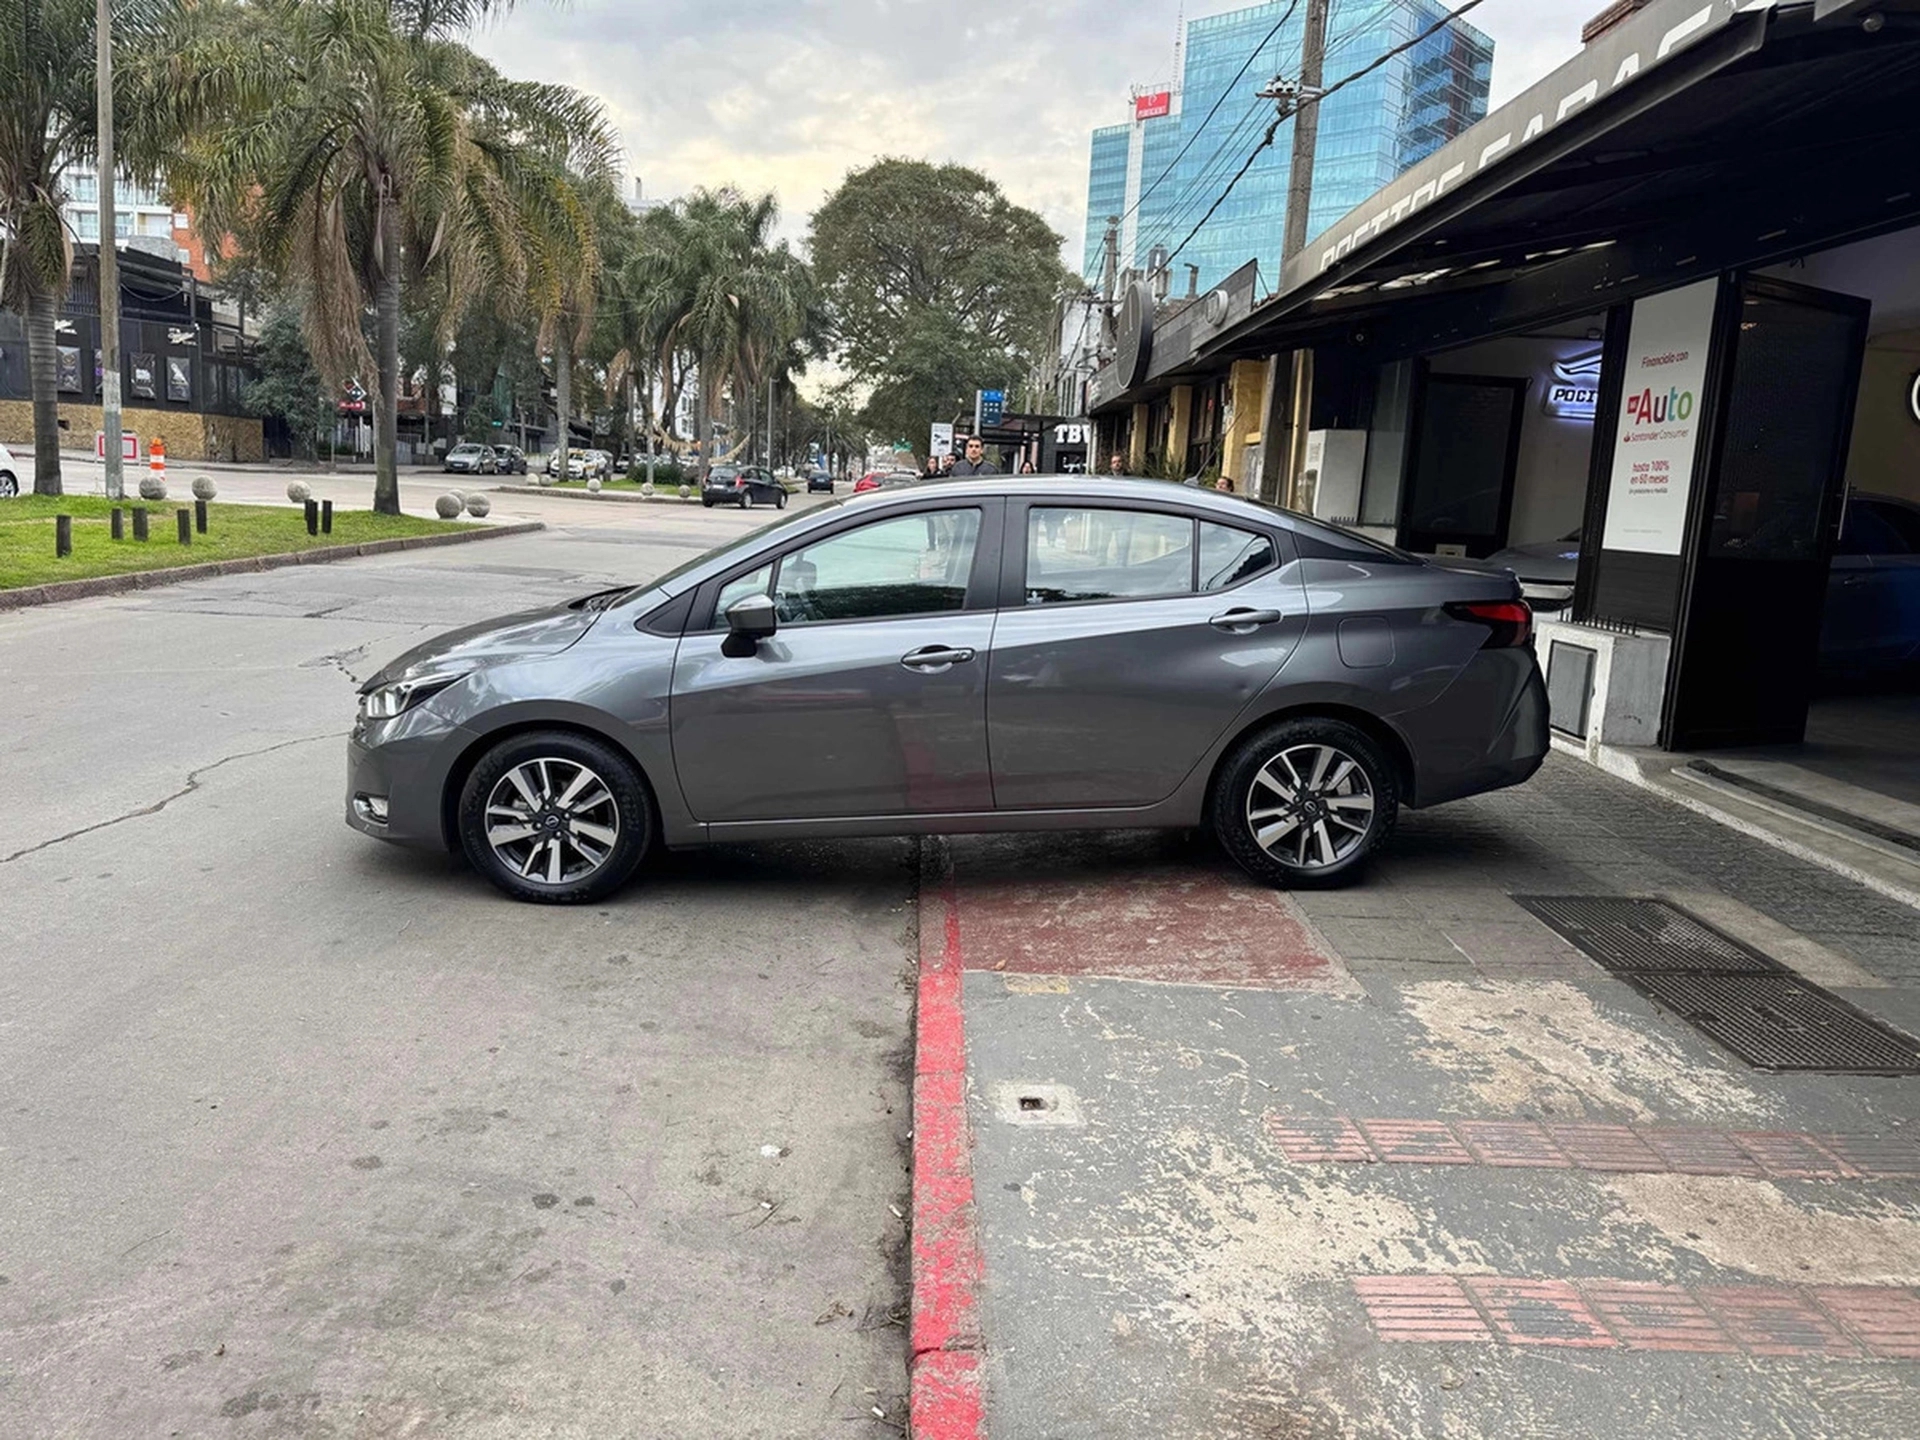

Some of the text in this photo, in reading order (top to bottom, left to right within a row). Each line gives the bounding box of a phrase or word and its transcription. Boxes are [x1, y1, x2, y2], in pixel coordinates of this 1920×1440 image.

[1553, 388, 1598, 403] POCI
[1632, 460, 1670, 473] hasta 100%
[1630, 476, 1639, 485] en
